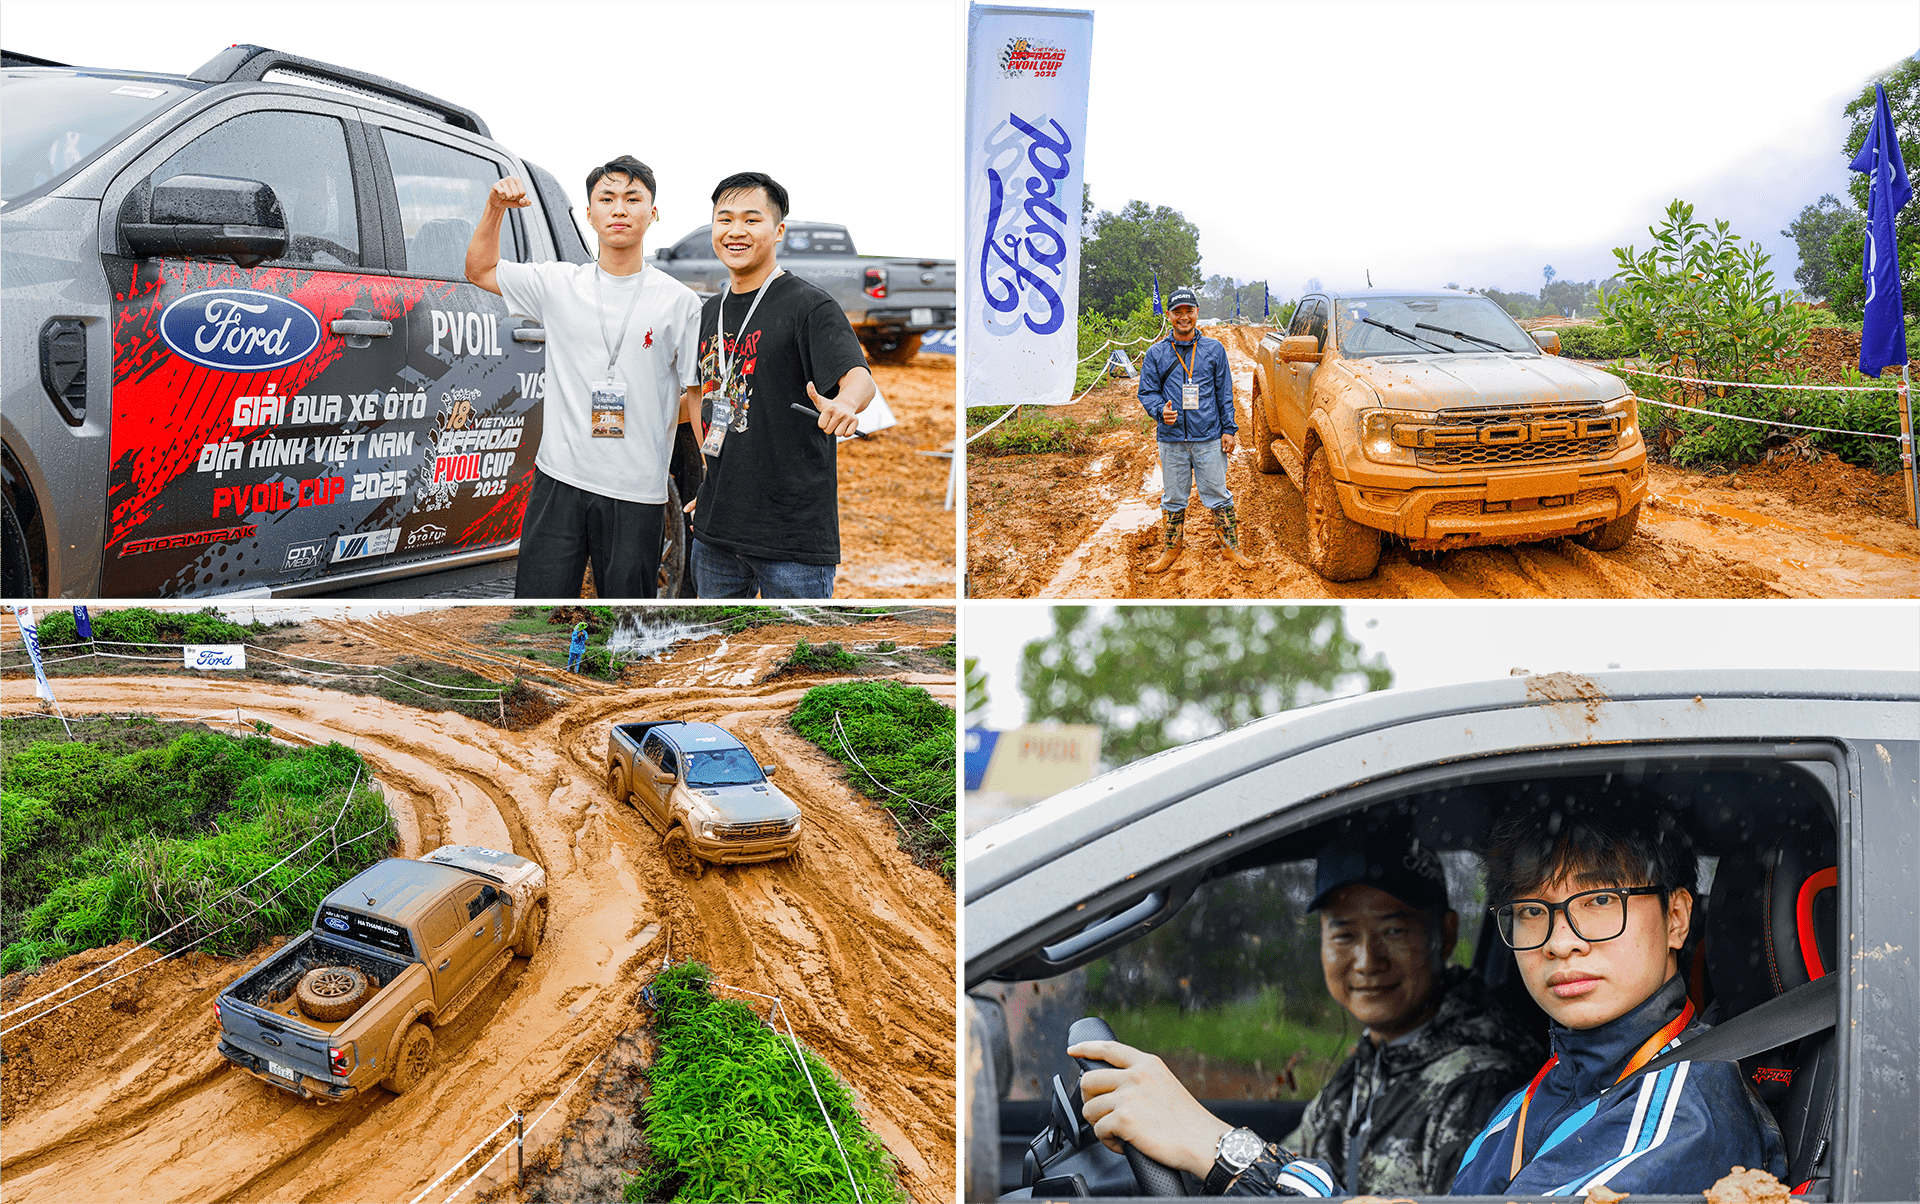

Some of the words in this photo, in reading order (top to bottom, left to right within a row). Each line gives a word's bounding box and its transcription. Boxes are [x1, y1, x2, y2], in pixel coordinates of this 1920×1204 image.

[1007, 60, 1038, 70] PVOIL
[1039, 61, 1062, 71] CUP
[1010, 51, 1066, 60] OFFROAD
[980, 112, 1073, 336] Ford
[194, 298, 292, 356] Ford
[431, 310, 503, 356] PVOIL
[232, 383, 287, 427] GIẢI
[291, 394, 343, 424] ĐUA
[347, 393, 379, 422] XE
[383, 386, 428, 421] ÔTÔ
[446, 400, 471, 429] 18
[474, 416, 525, 429] VIETNAM
[1417, 416, 1621, 447] FORD
[197, 436, 246, 479] ĐỊA
[249, 433, 309, 469] HÌNH
[313, 429, 366, 468] VIỆT
[367, 431, 415, 459] NAM
[438, 427, 523, 453] OFFROAD
[433, 452, 481, 484] PVOIL
[481, 451, 516, 479] CUP
[212, 481, 292, 519] PVOIL
[298, 476, 346, 508] CUP
[350, 470, 408, 502] 2025
[472, 479, 508, 499] 2025
[117, 524, 259, 558] STORMTRAK
[288, 544, 323, 560] OTV
[284, 556, 319, 569] MEDIA
[196, 650, 233, 666] Ford
